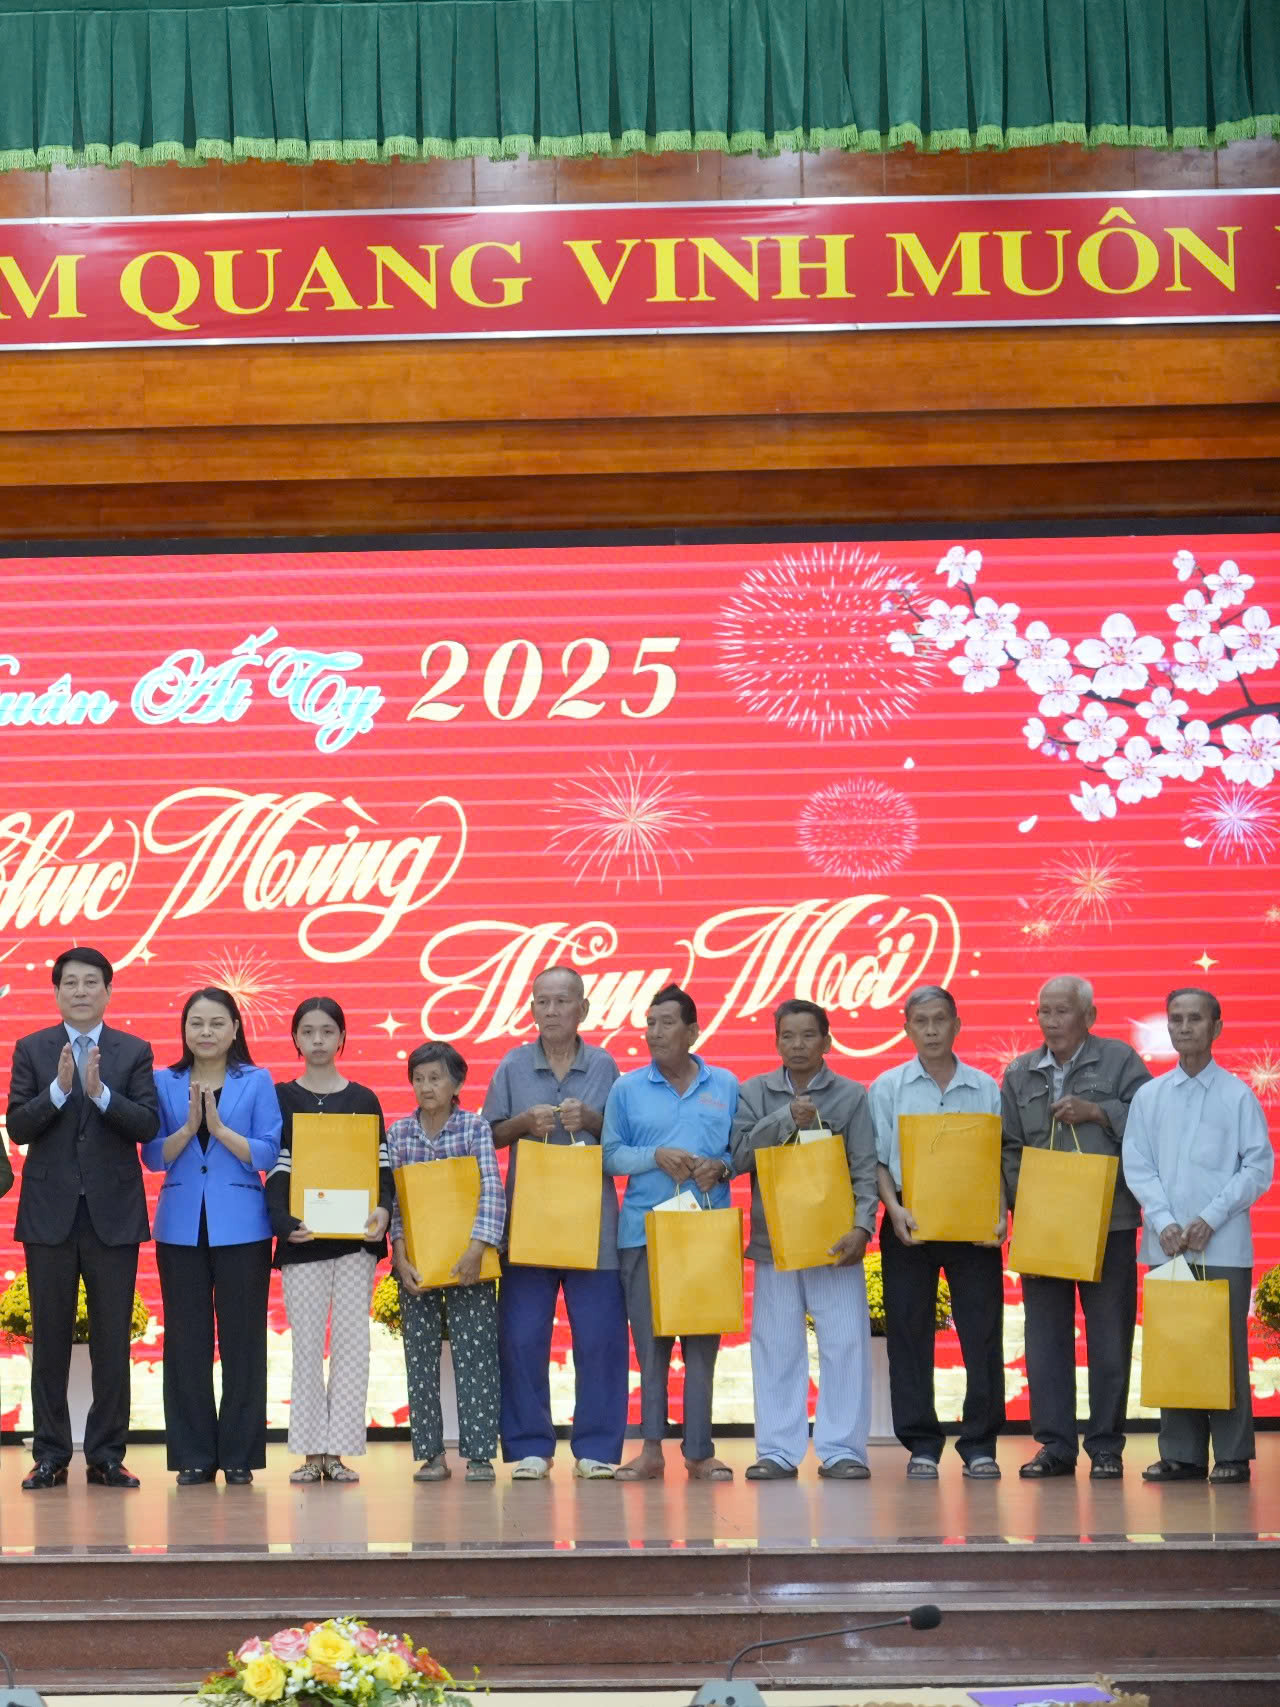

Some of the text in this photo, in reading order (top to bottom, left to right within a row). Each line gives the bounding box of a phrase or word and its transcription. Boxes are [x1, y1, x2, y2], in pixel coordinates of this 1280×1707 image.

[119, 242, 532, 332] QUANG
[563, 233, 857, 305] VINH
[886, 207, 1243, 297] MUÔN
[130, 625, 279, 725] Ất
[264, 646, 386, 754] Tỵ
[406, 637, 681, 722] 2025
[112, 787, 468, 973] Mừng
[420, 893, 961, 1058] Nm Mới
